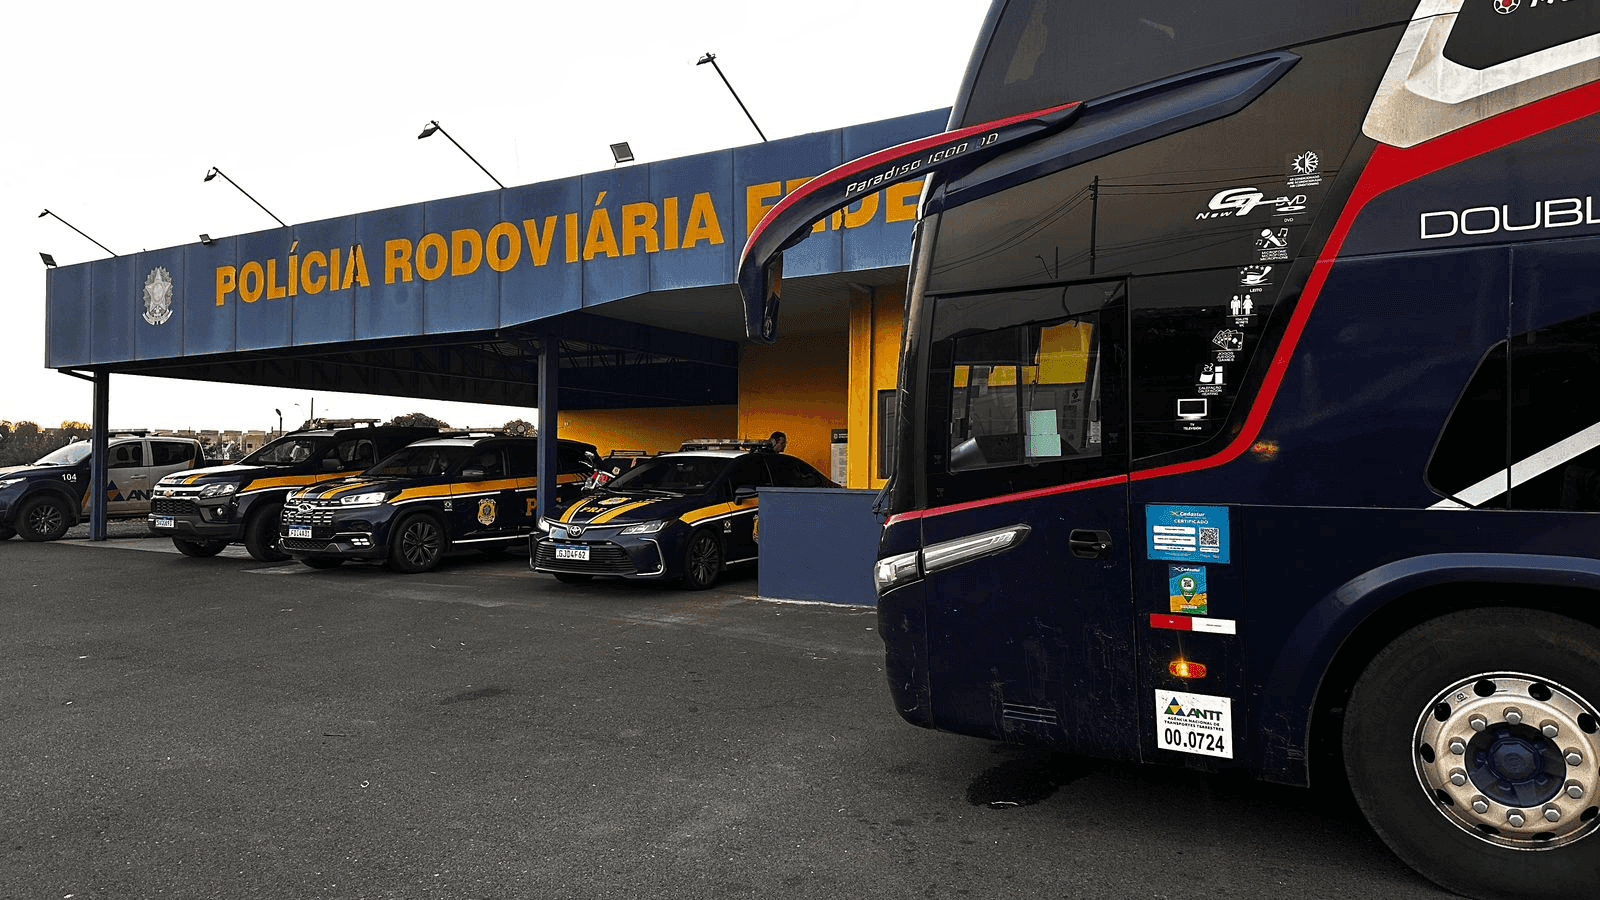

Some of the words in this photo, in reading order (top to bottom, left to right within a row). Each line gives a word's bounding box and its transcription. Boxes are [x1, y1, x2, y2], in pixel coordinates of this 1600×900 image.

[845, 159, 922, 197] Paradiso
[216, 240, 370, 306] POLÍCIA
[384, 191, 725, 284] RODOVIÁRIA
[62, 473, 77, 481] 104
[1187, 708, 1223, 721] ANTT
[1164, 727, 1225, 753] 00.0724
